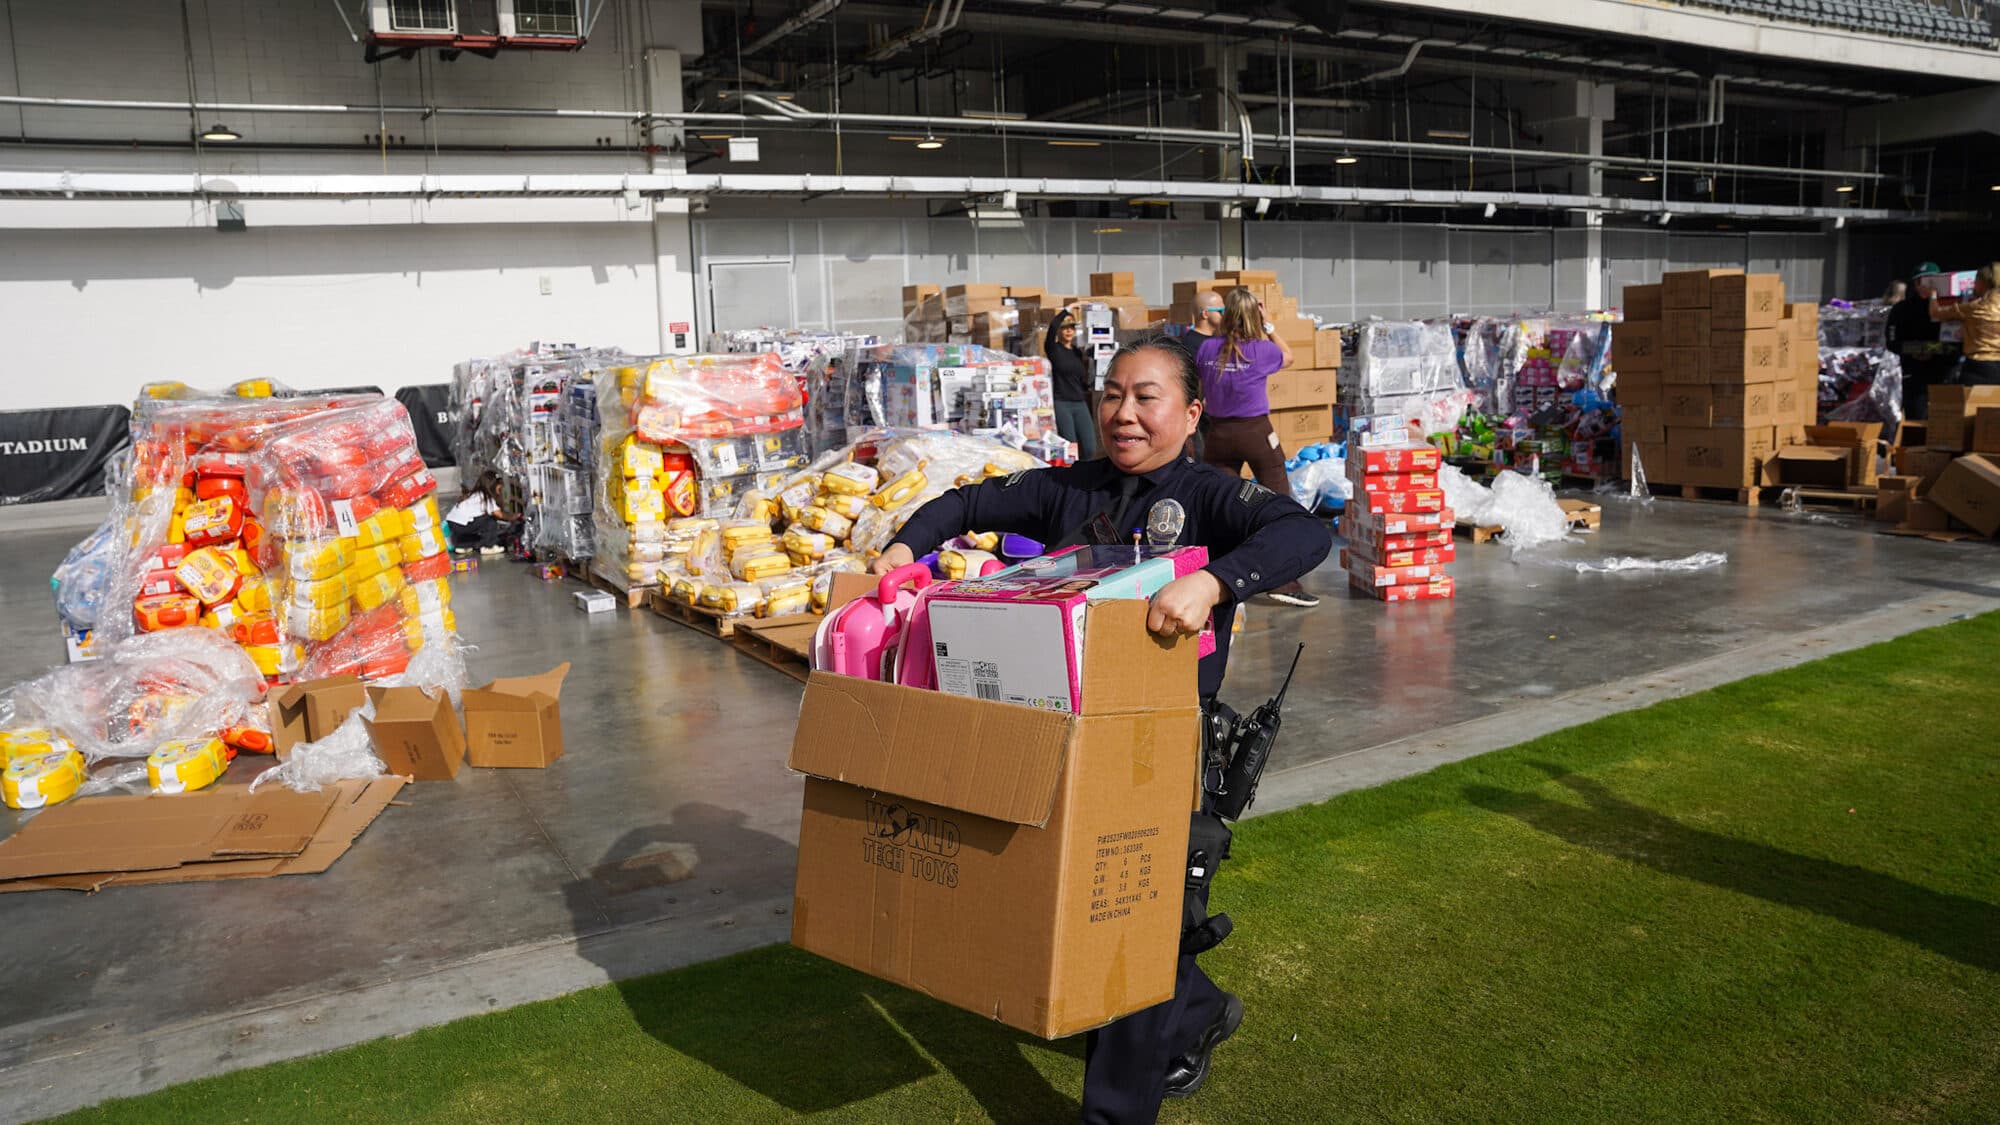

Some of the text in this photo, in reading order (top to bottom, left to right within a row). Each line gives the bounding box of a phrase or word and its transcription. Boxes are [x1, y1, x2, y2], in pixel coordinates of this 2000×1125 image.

[0, 437, 88, 455] TADIUM
[341, 510, 353, 528] 4
[865, 800, 960, 858] WORLD
[862, 837, 959, 888] TECH TOYS
[1140, 853, 1152, 863] PCS
[1139, 865, 1152, 876] KGS
[1138, 878, 1150, 888] KGS
[1089, 911, 1106, 923] MADE
[1113, 907, 1131, 919] CHINA
